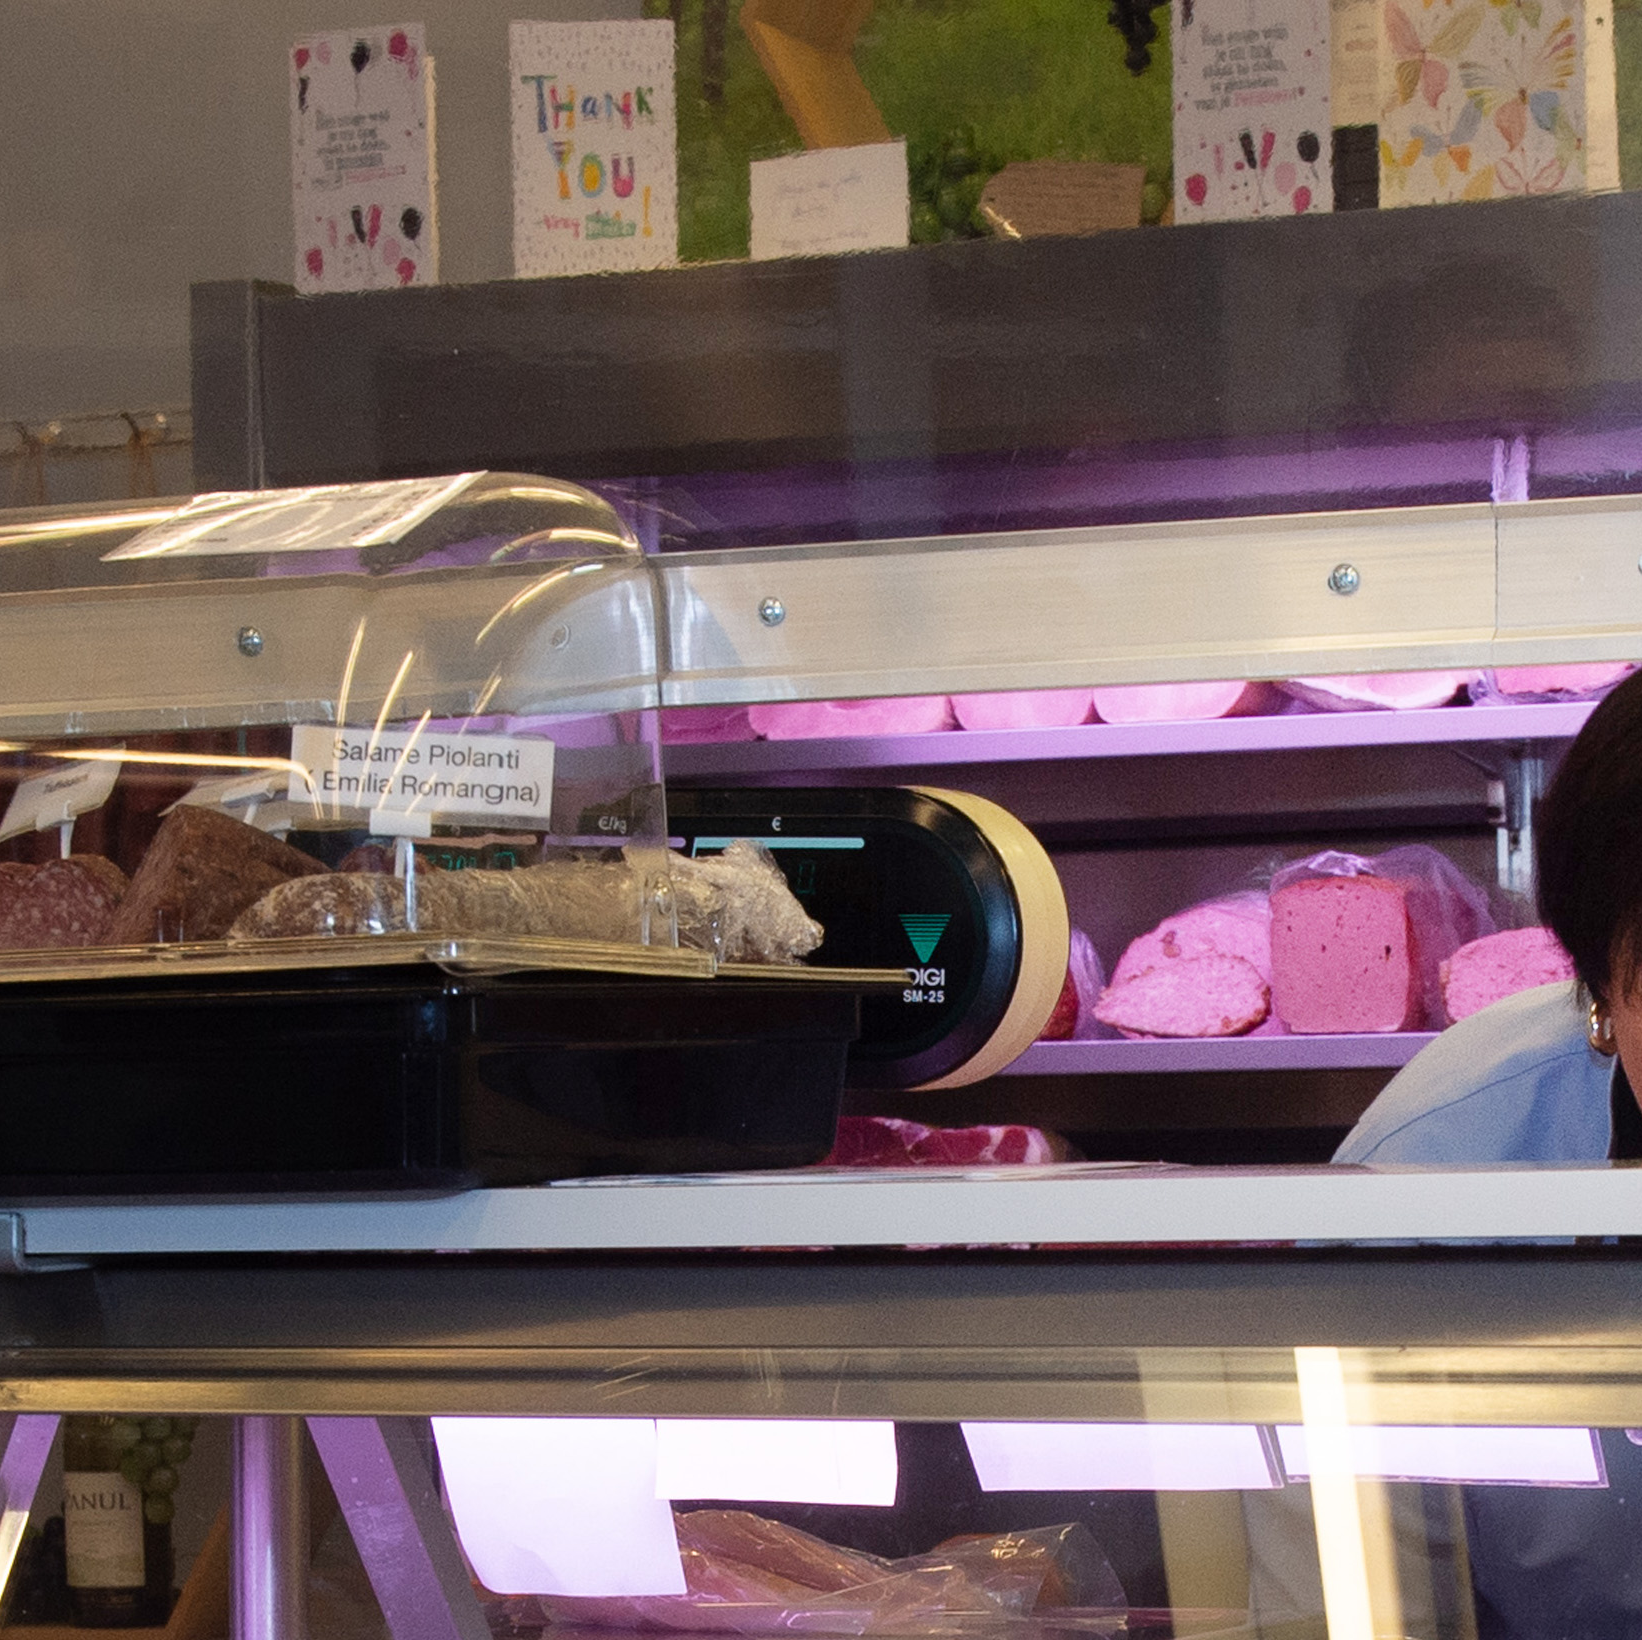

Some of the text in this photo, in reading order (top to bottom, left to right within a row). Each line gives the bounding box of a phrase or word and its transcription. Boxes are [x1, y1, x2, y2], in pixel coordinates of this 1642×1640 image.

[546, 139, 634, 200] YOU
[333, 740, 520, 769] Salame Piolanti
[323, 770, 392, 794] Emilia
[401, 776, 541, 806] Romangna)
[772, 816, 781, 831] €
[905, 968, 945, 986] DIGI
[903, 989, 945, 1003] SM-25
